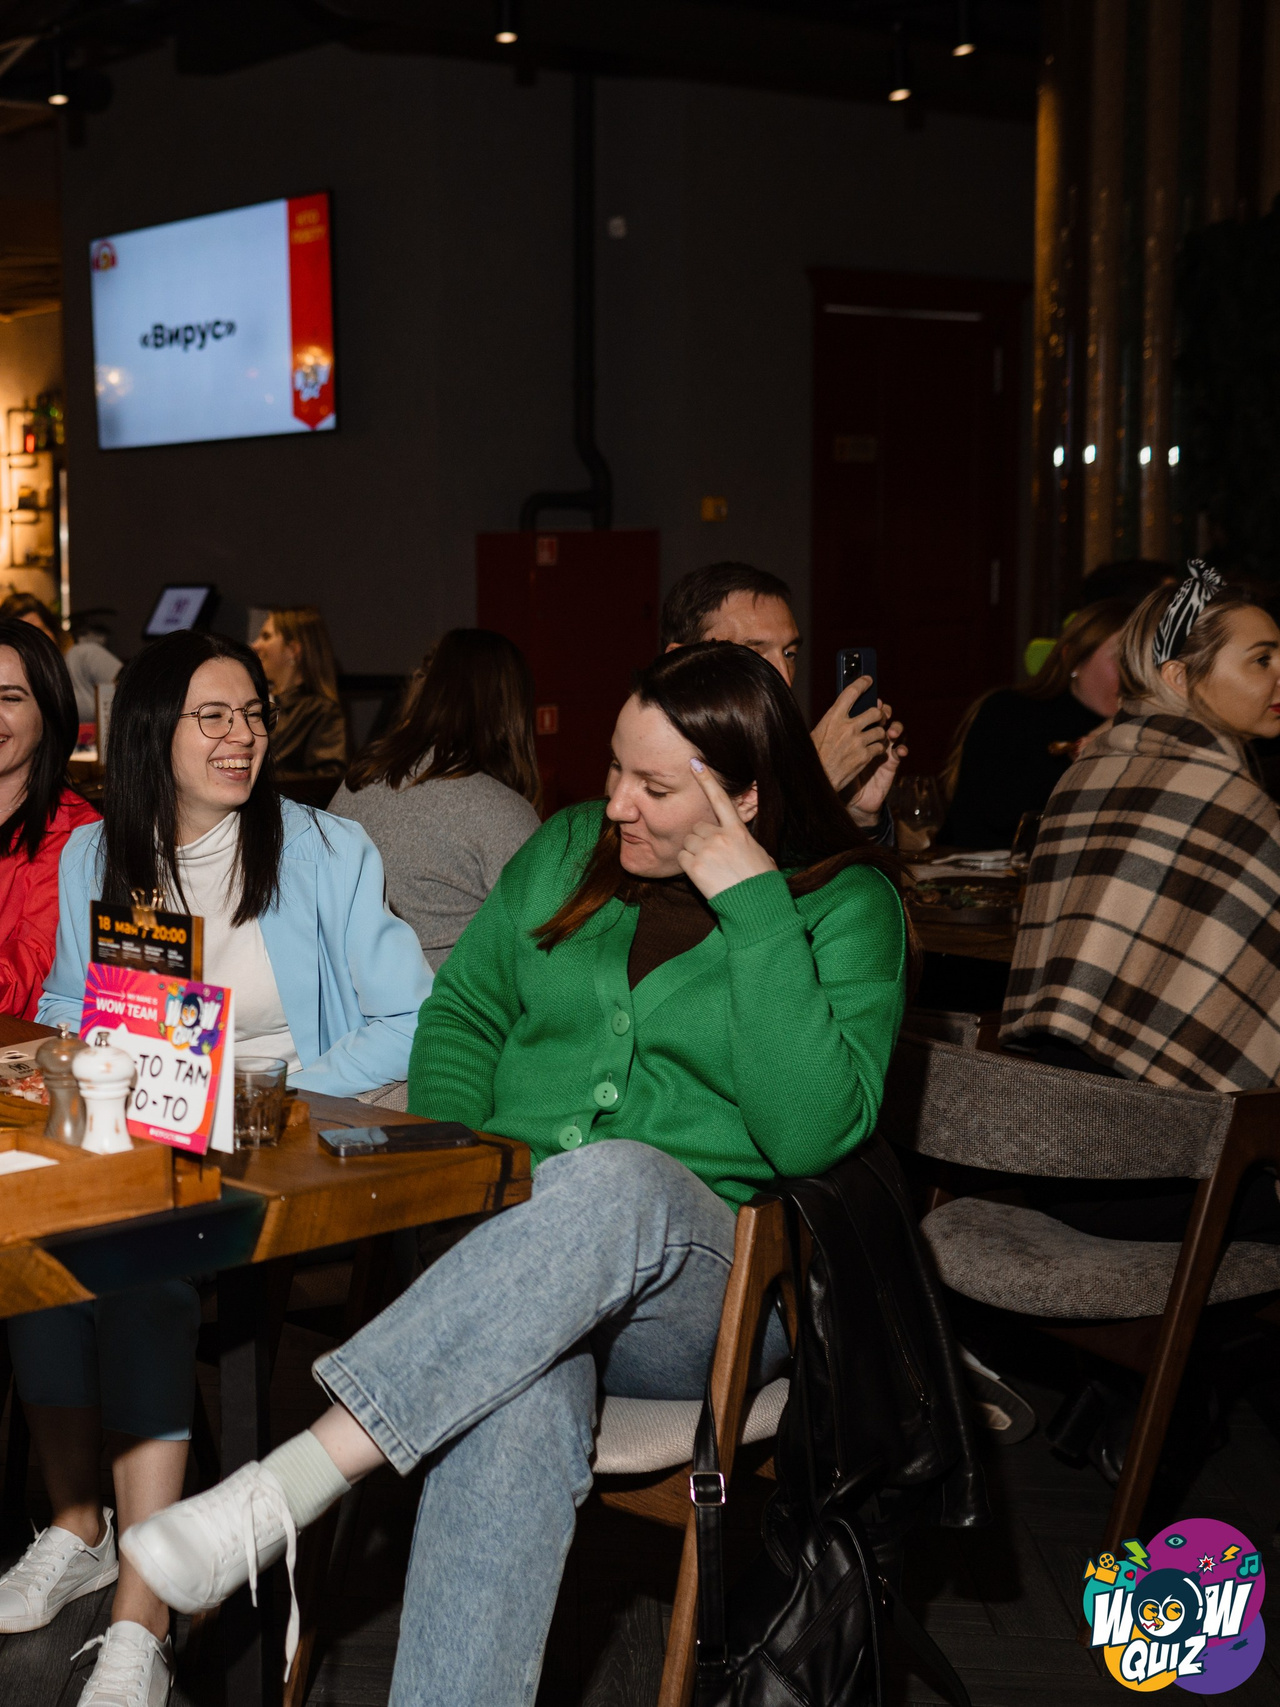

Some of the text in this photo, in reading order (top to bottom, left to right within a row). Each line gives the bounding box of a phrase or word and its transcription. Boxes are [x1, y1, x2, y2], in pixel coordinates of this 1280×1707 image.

[140, 319, 237, 351] «Вирус»
[98, 914, 111, 931] 18
[152, 925, 187, 944] 20:00
[96, 997, 158, 1022] WOW TEAM
[175, 1059, 209, 1088] ТАМ
